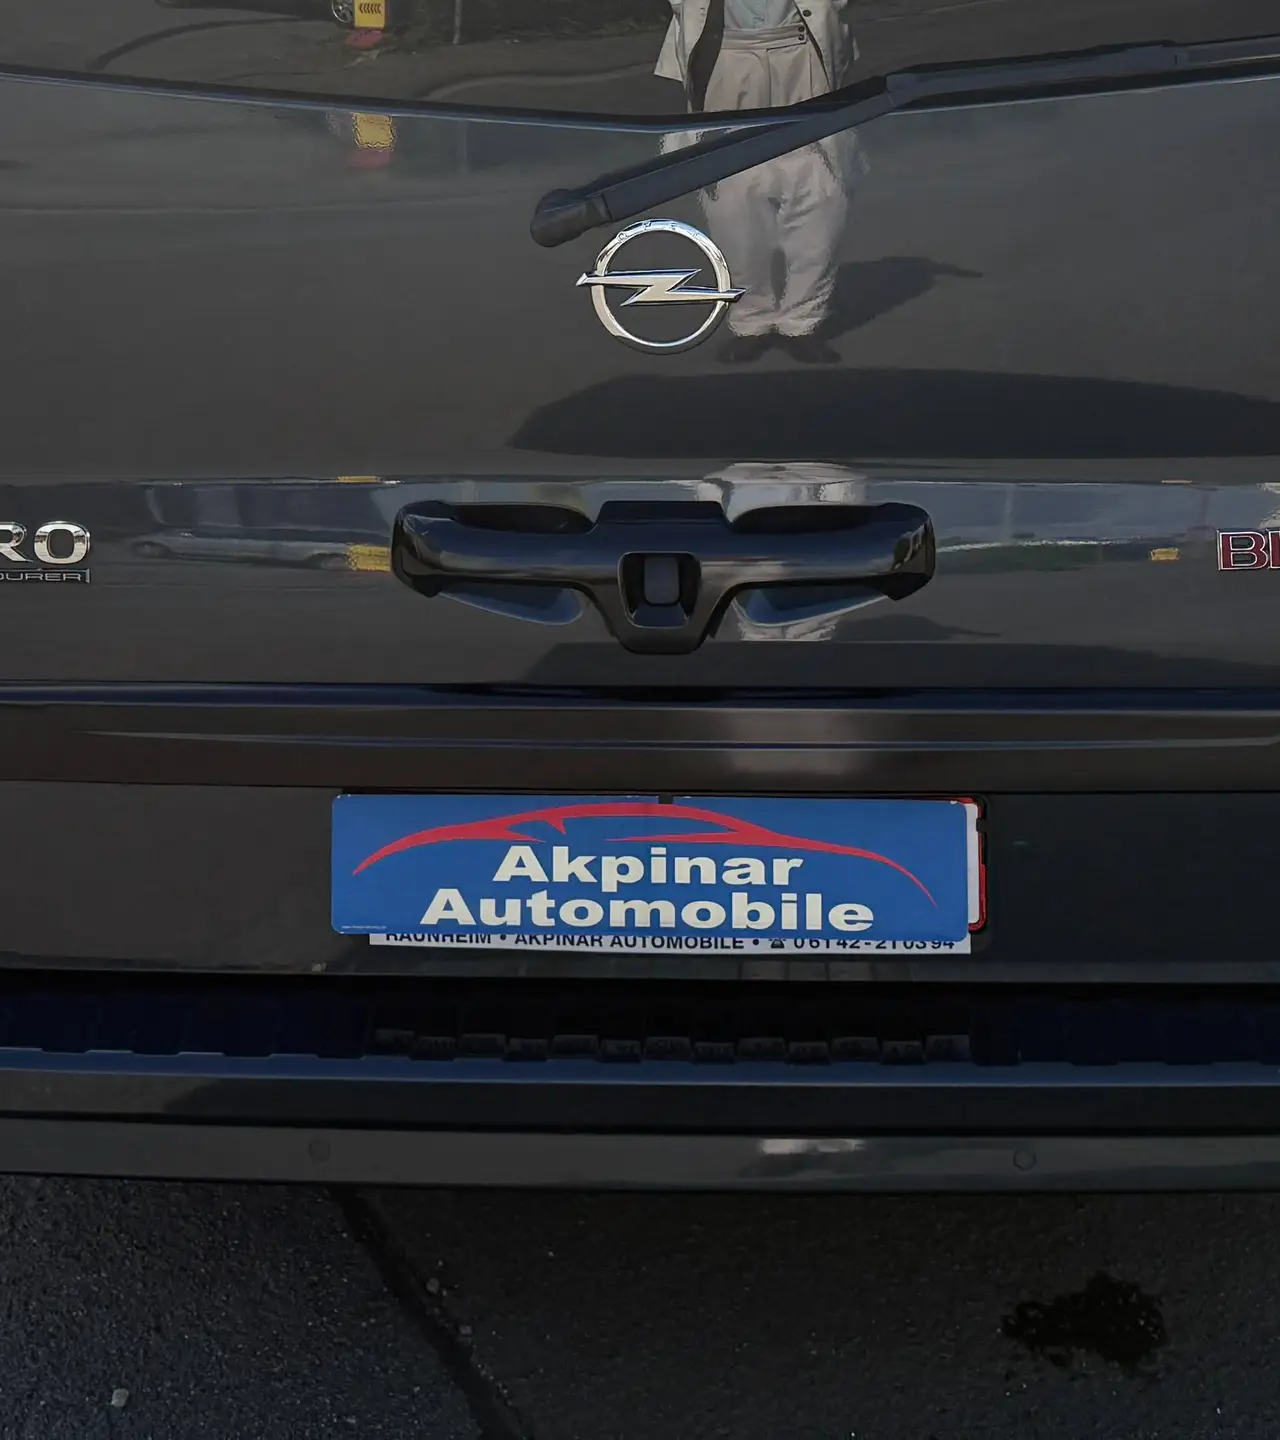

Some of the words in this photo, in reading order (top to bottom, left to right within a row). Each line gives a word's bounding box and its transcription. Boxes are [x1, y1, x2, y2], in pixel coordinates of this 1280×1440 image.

[493, 845, 803, 893] Akpinar
[420, 888, 875, 933] Automobile
[385, 933, 492, 945] RAUNHEIM
[514, 934, 603, 948] AKPINAR
[609, 935, 745, 950] AUTOMOBILE
